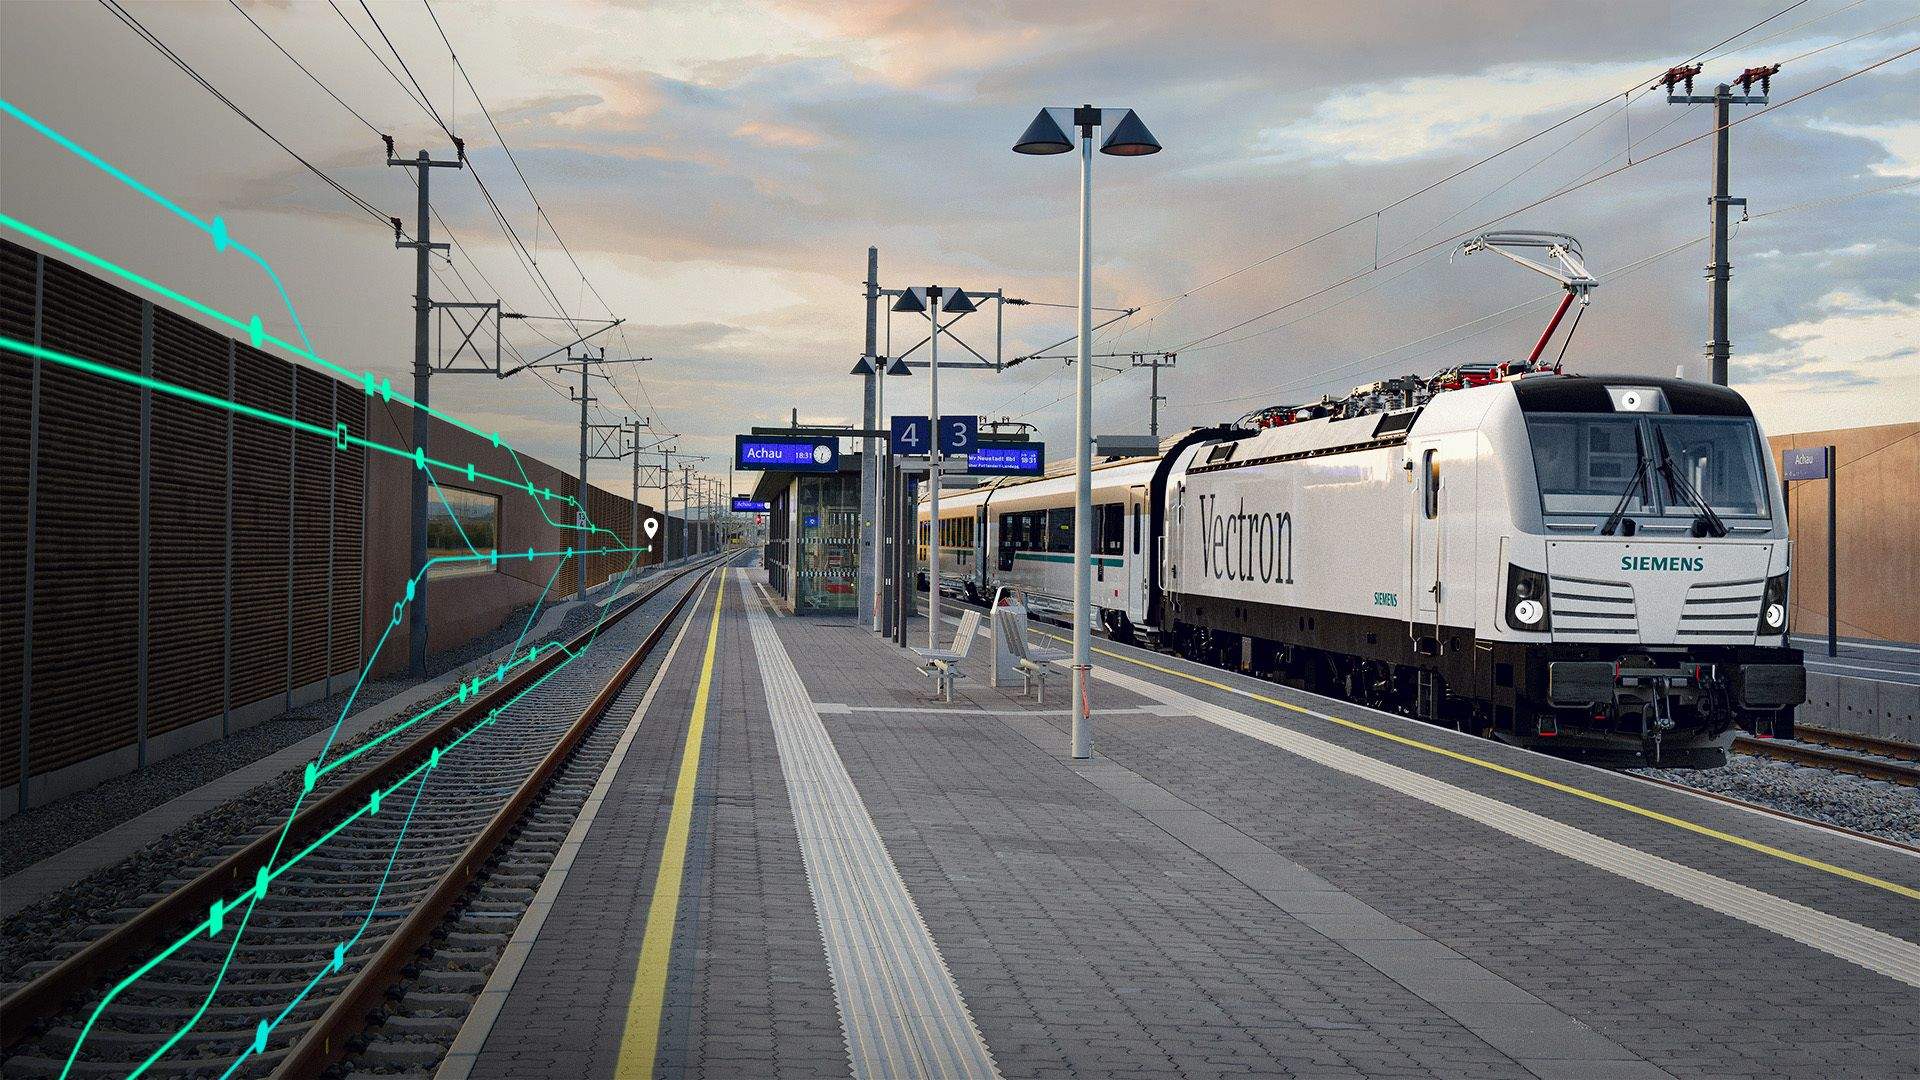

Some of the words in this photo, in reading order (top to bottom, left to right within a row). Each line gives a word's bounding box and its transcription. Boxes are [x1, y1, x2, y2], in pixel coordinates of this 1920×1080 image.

[900, 423, 919, 447] 4
[952, 422, 967, 447] 3
[747, 447, 783, 459] Achau
[1199, 493, 1294, 585] Vectron
[1621, 556, 1704, 572] SIEMENS
[1373, 592, 1398, 607] SIEMENS
